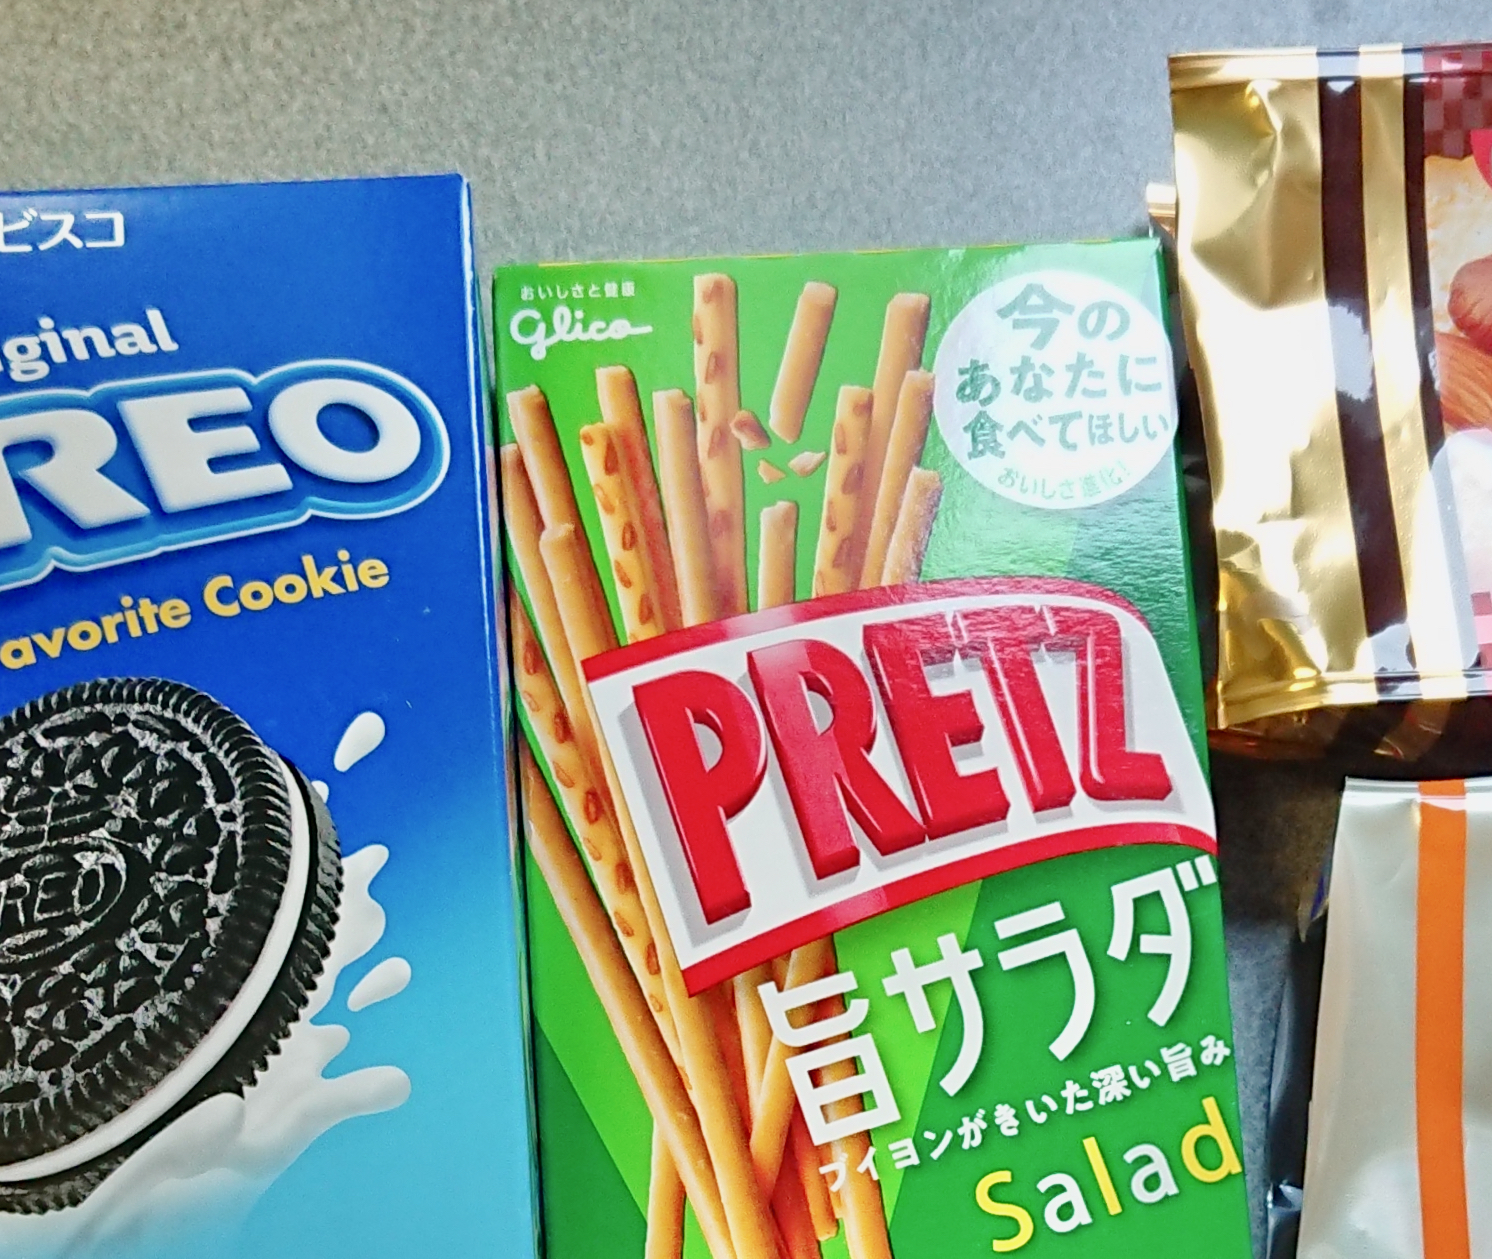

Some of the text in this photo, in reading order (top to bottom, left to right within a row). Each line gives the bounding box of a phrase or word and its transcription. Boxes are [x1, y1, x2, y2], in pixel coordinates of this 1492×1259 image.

[519, 282, 637, 302] おいしさと健康
[995, 282, 1132, 352] 今の
[955, 351, 1163, 408] あなたに
[962, 409, 1170, 461] 食べてほしい
[204, 550, 390, 621] Cookie
[631, 604, 1174, 927] PRETZ
[757, 854, 1219, 1148] 旨サラダ
[818, 1034, 1232, 1193] ブイヨンがきいた深い旨み
[974, 1096, 1243, 1253] Salad
